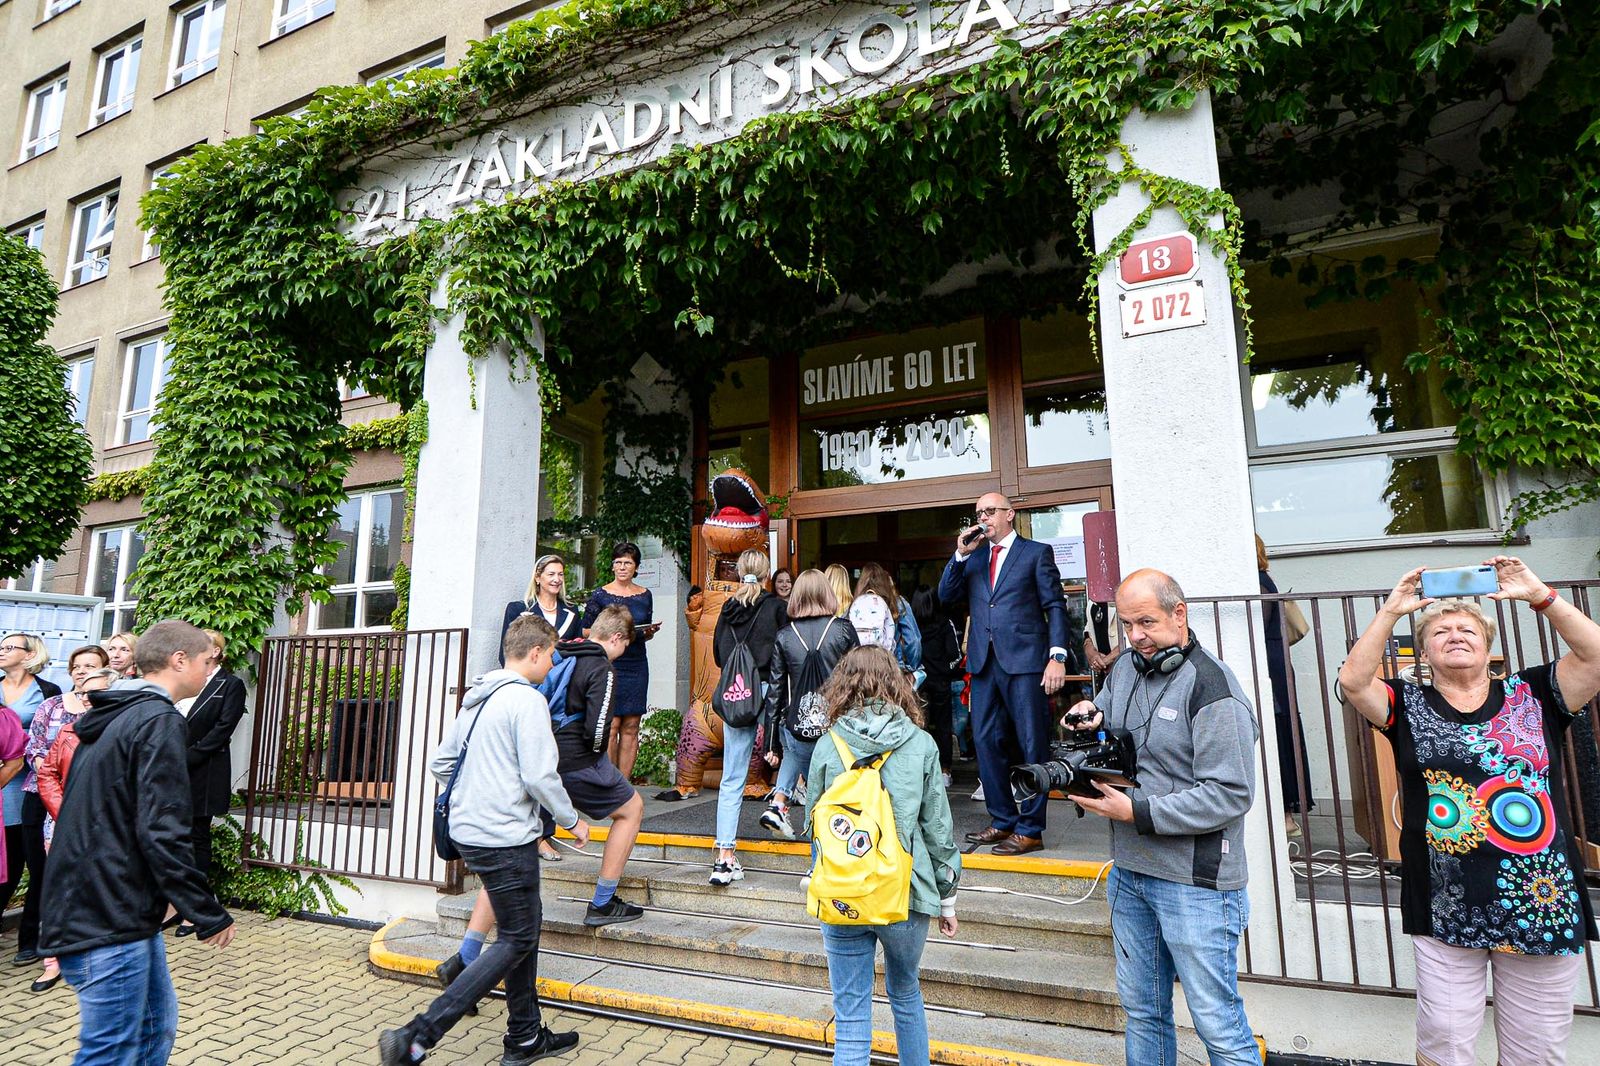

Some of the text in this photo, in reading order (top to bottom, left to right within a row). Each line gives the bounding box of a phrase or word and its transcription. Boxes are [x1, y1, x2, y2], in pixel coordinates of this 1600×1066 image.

[359, 175, 427, 234] 21.
[445, 52, 735, 205] ZÁKLADNÍ
[1138, 245, 1171, 274] 13
[803, 341, 977, 406] SLAVÍME 60 LET
[820, 429, 872, 472] 1960
[904, 416, 967, 463] 2020
[723, 688, 752, 702] adds
[801, 728, 830, 739] QUEE
